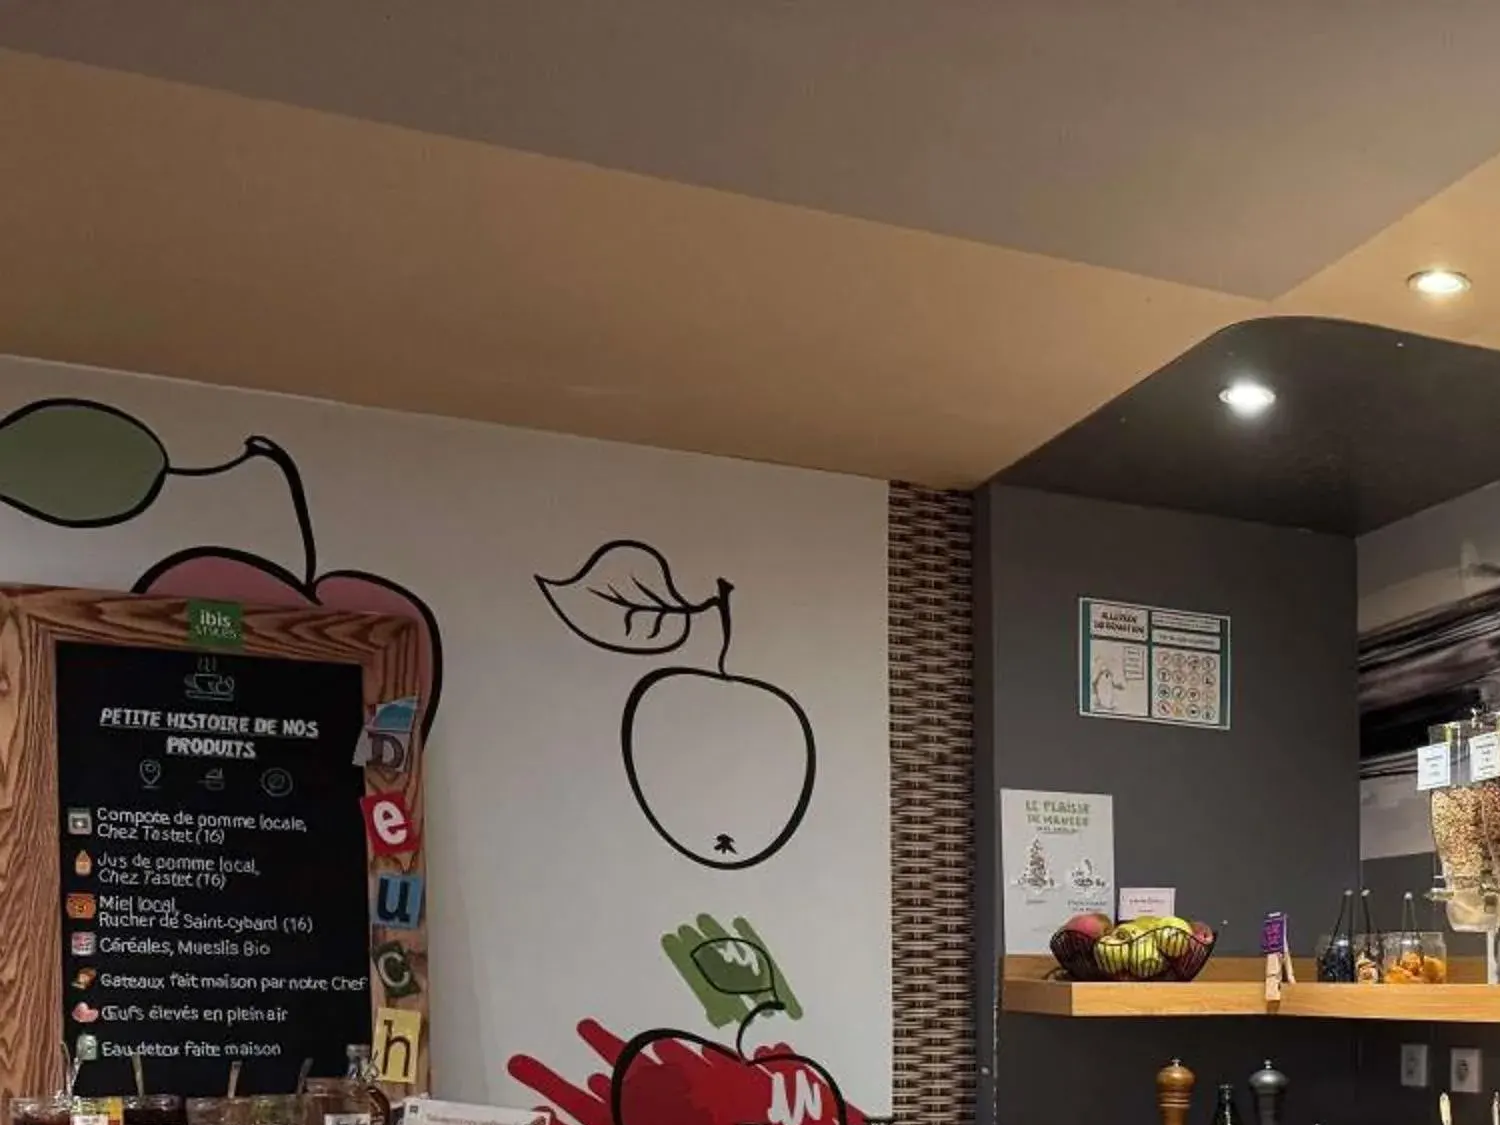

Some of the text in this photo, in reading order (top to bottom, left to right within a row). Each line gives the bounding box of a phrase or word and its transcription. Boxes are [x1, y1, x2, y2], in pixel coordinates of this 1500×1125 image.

[200, 609, 232, 628] ibis
[100, 707, 320, 738] PETITE HISTOIRE DE NOS
[165, 736, 257, 759] PRODUITS
[97, 807, 308, 833] Compote de pomme locale,
[97, 823, 225, 845] Chez Tastet (16)
[97, 853, 127, 868] Jus
[132, 853, 151, 869] de
[155, 857, 215, 875] pomme
[97, 869, 227, 889] Chez Tastet (16)
[99, 895, 133, 912] Miel
[99, 912, 155, 928] Rucher
[159, 913, 178, 929] de
[283, 917, 313, 934] (16)
[100, 937, 271, 957] Céréales, Mueslis Bio
[169, 973, 199, 990] fait
[200, 973, 257, 990] maison
[260, 978, 287, 993] par
[289, 977, 328, 991] notre
[331, 976, 368, 991] Chef
[203, 1007, 223, 1021] en
[227, 1006, 265, 1024] plein
[266, 1007, 289, 1022] air
[101, 1041, 132, 1058] Eau
[184, 1040, 221, 1057] faite
[224, 1041, 281, 1057] maison
